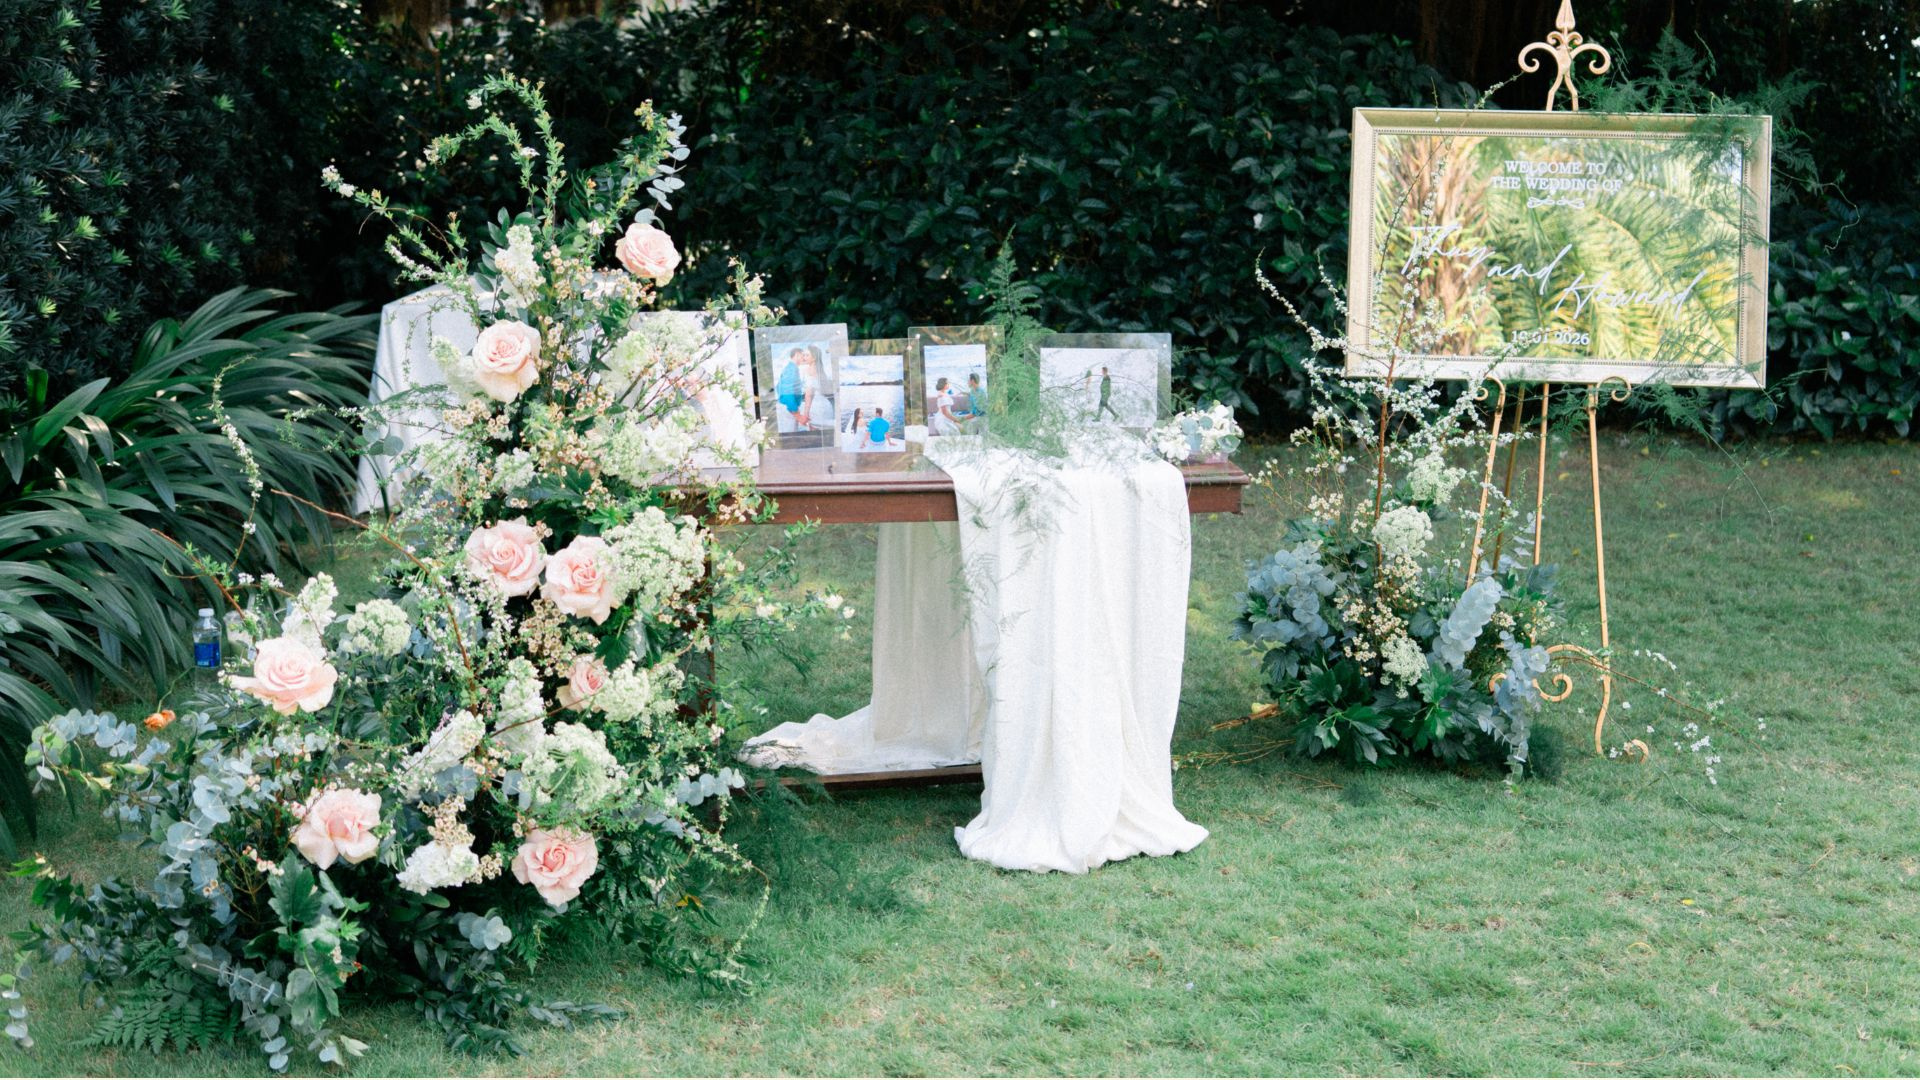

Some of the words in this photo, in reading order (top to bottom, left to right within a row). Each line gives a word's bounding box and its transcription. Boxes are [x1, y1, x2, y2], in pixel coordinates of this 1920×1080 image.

[1504, 160, 1584, 174] WELCOME
[1586, 162, 1607, 175] TO
[1491, 176, 1521, 189] THE
[1525, 178, 1597, 191] WEDDING
[1602, 179, 1624, 192] OF
[1487, 243, 1573, 296] and
[1554, 270, 1708, 320] Howard
